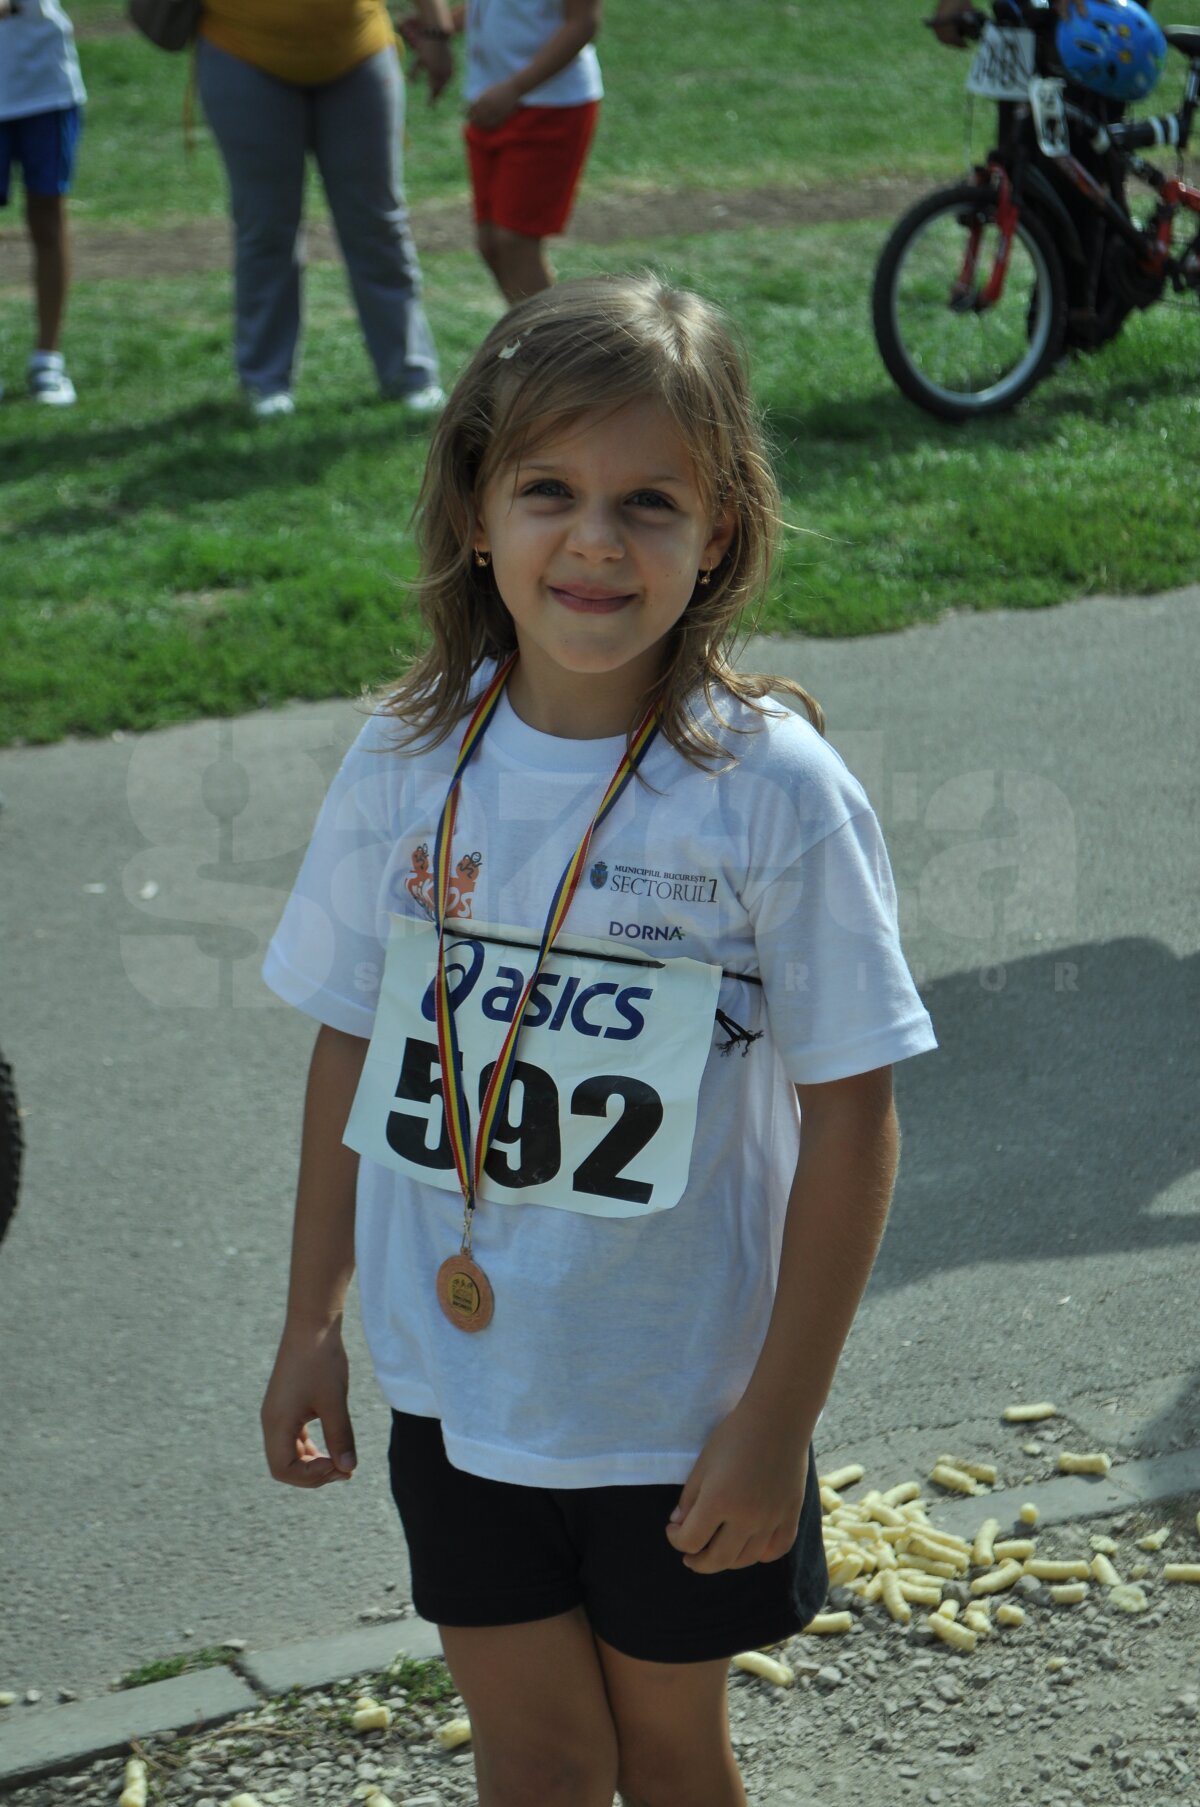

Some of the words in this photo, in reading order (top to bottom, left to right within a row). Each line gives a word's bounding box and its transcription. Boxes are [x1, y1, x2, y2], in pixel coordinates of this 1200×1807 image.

[615, 865, 661, 878] MUNICIPIUL
[609, 921, 683, 941] DORNA
[386, 1037, 664, 1205] 592
